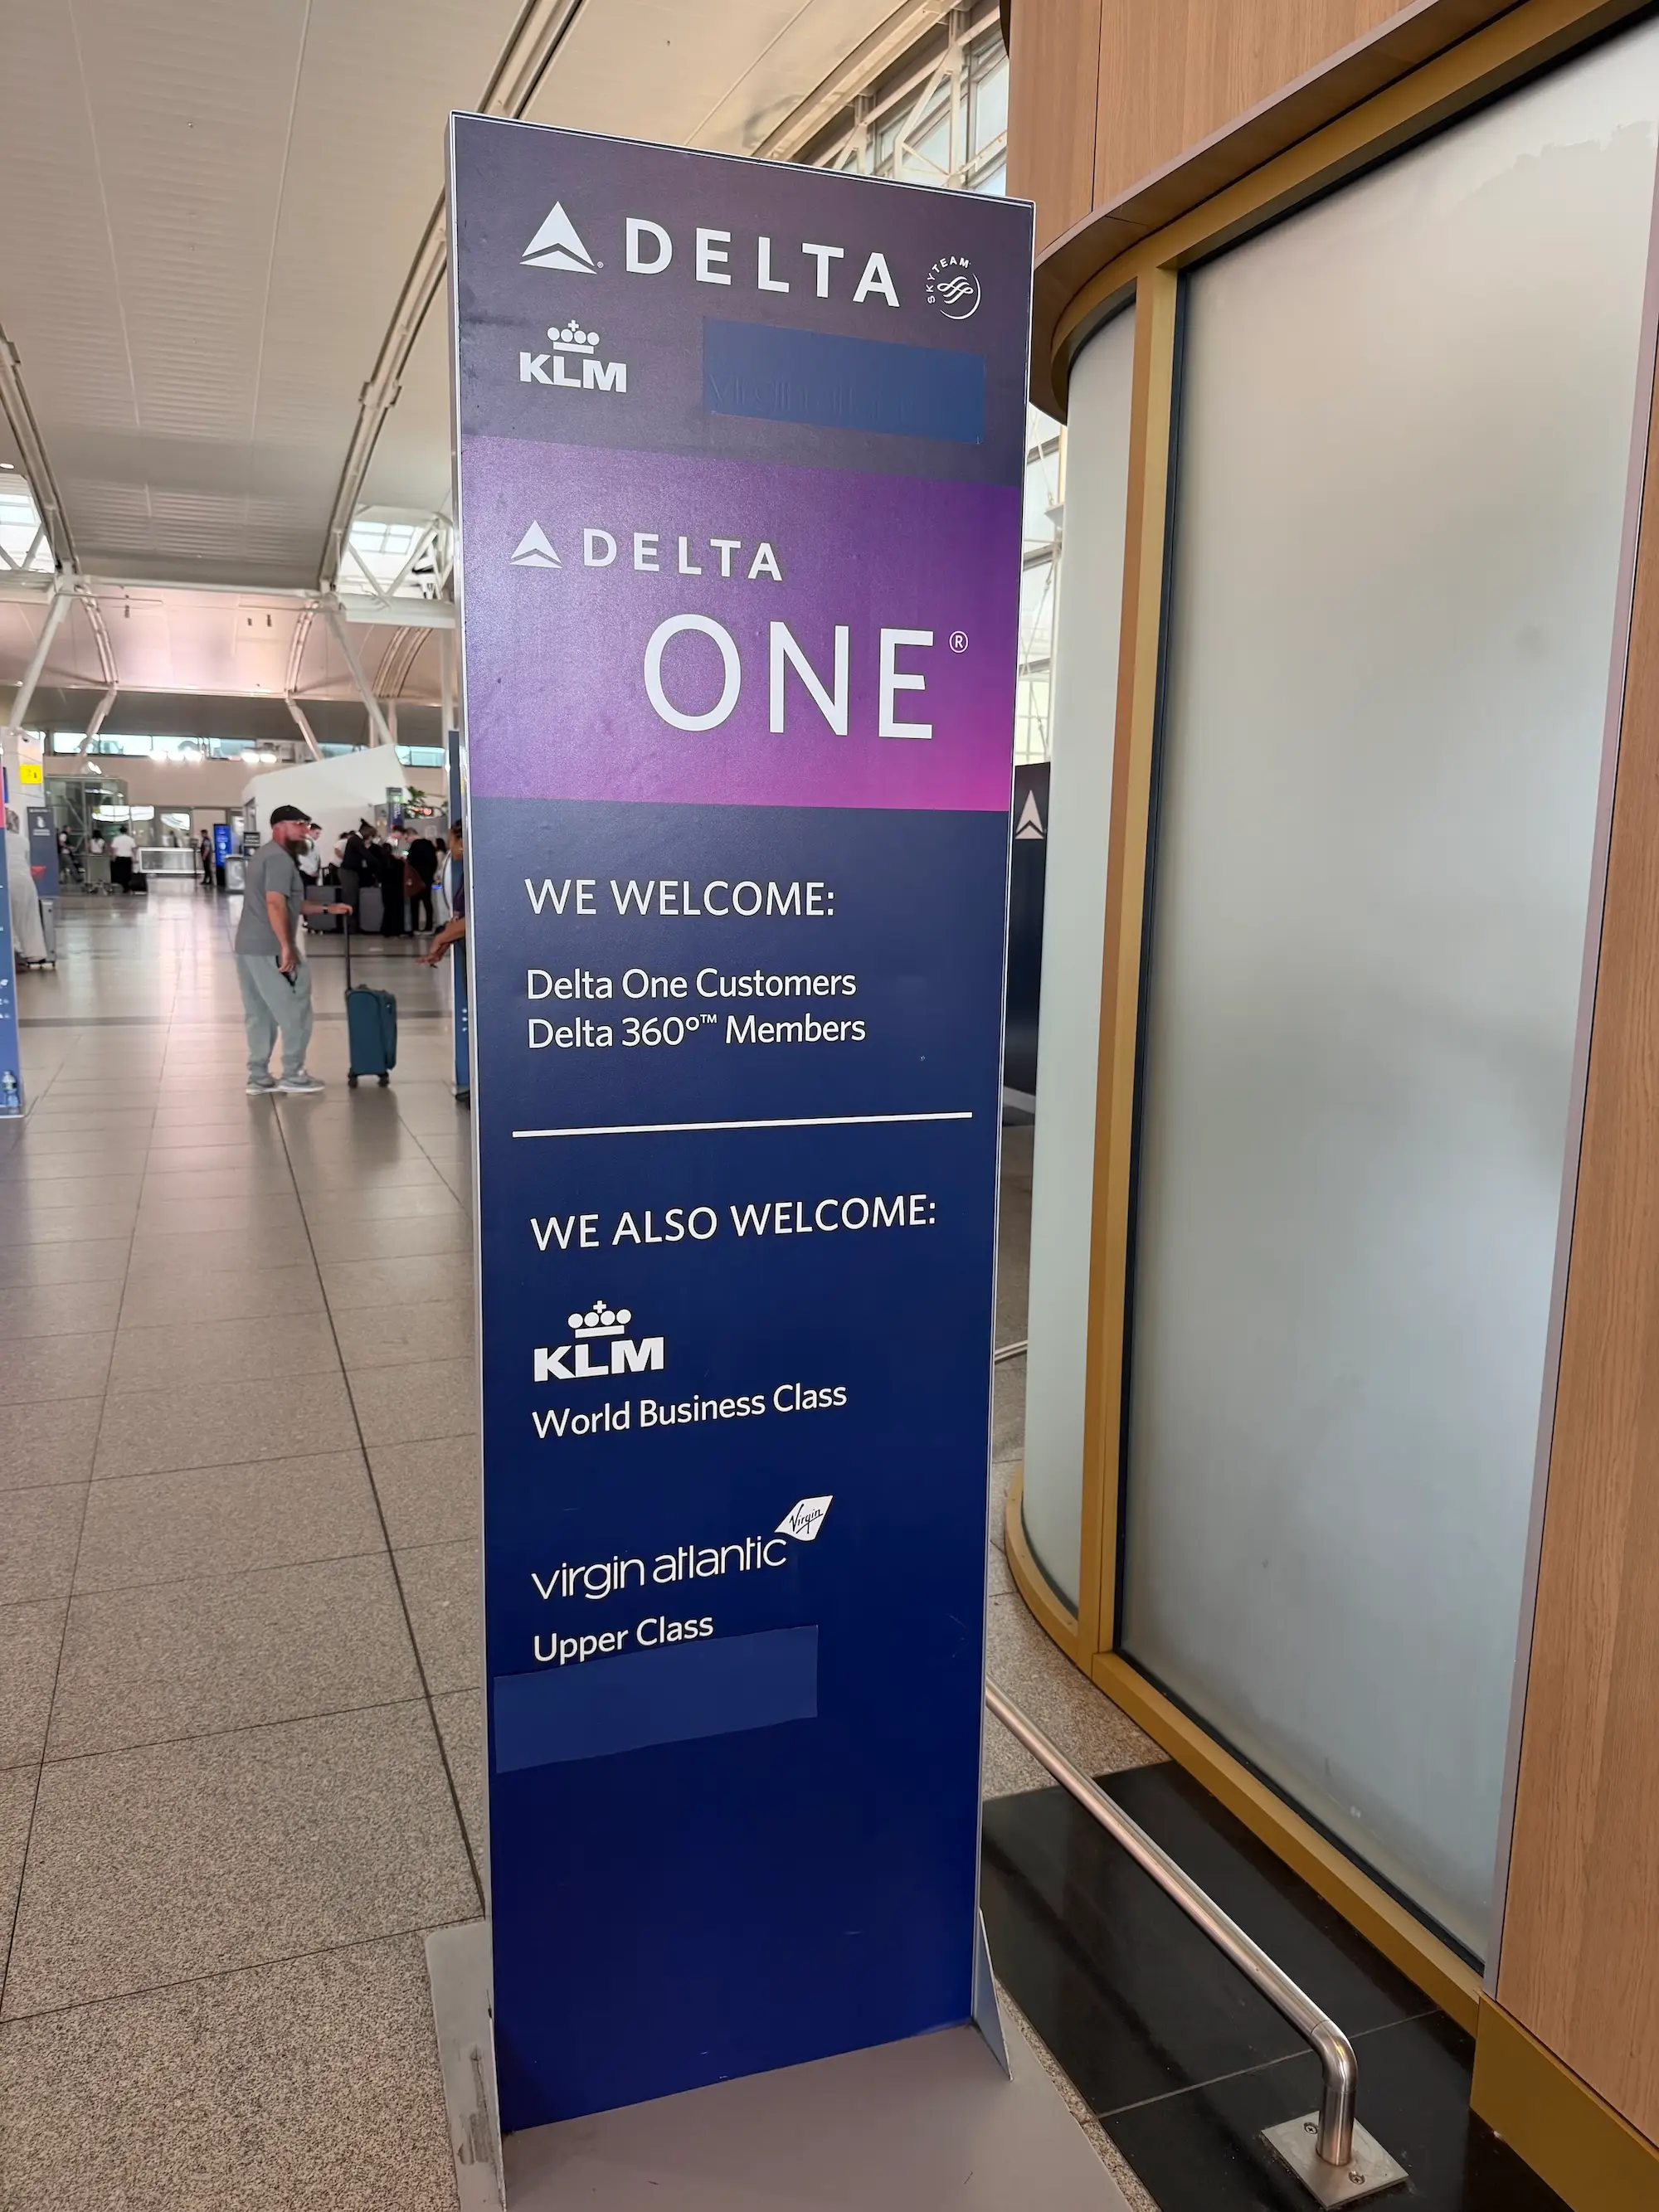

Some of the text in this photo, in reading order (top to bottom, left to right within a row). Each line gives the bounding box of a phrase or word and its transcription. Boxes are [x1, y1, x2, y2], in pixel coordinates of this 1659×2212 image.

[626, 217, 899, 307] DELTA
[926, 256, 970, 304] SKYTEAM
[520, 351, 626, 393] KLM
[583, 527, 783, 581] DELTA
[525, 879, 834, 916] WE WELCOME:
[528, 968, 857, 999] Delta One Customers
[528, 1017, 613, 1048] Delta
[725, 1013, 866, 1044] Members
[531, 1194, 936, 1251] WE ALSO WELCOME:
[533, 1336, 664, 1382] KLM
[532, 1382, 847, 1439] World Business Class
[789, 1504, 824, 1534] Virgin
[531, 1535, 787, 1601] virgin atlantic
[534, 1616, 714, 1665] Upper Class
